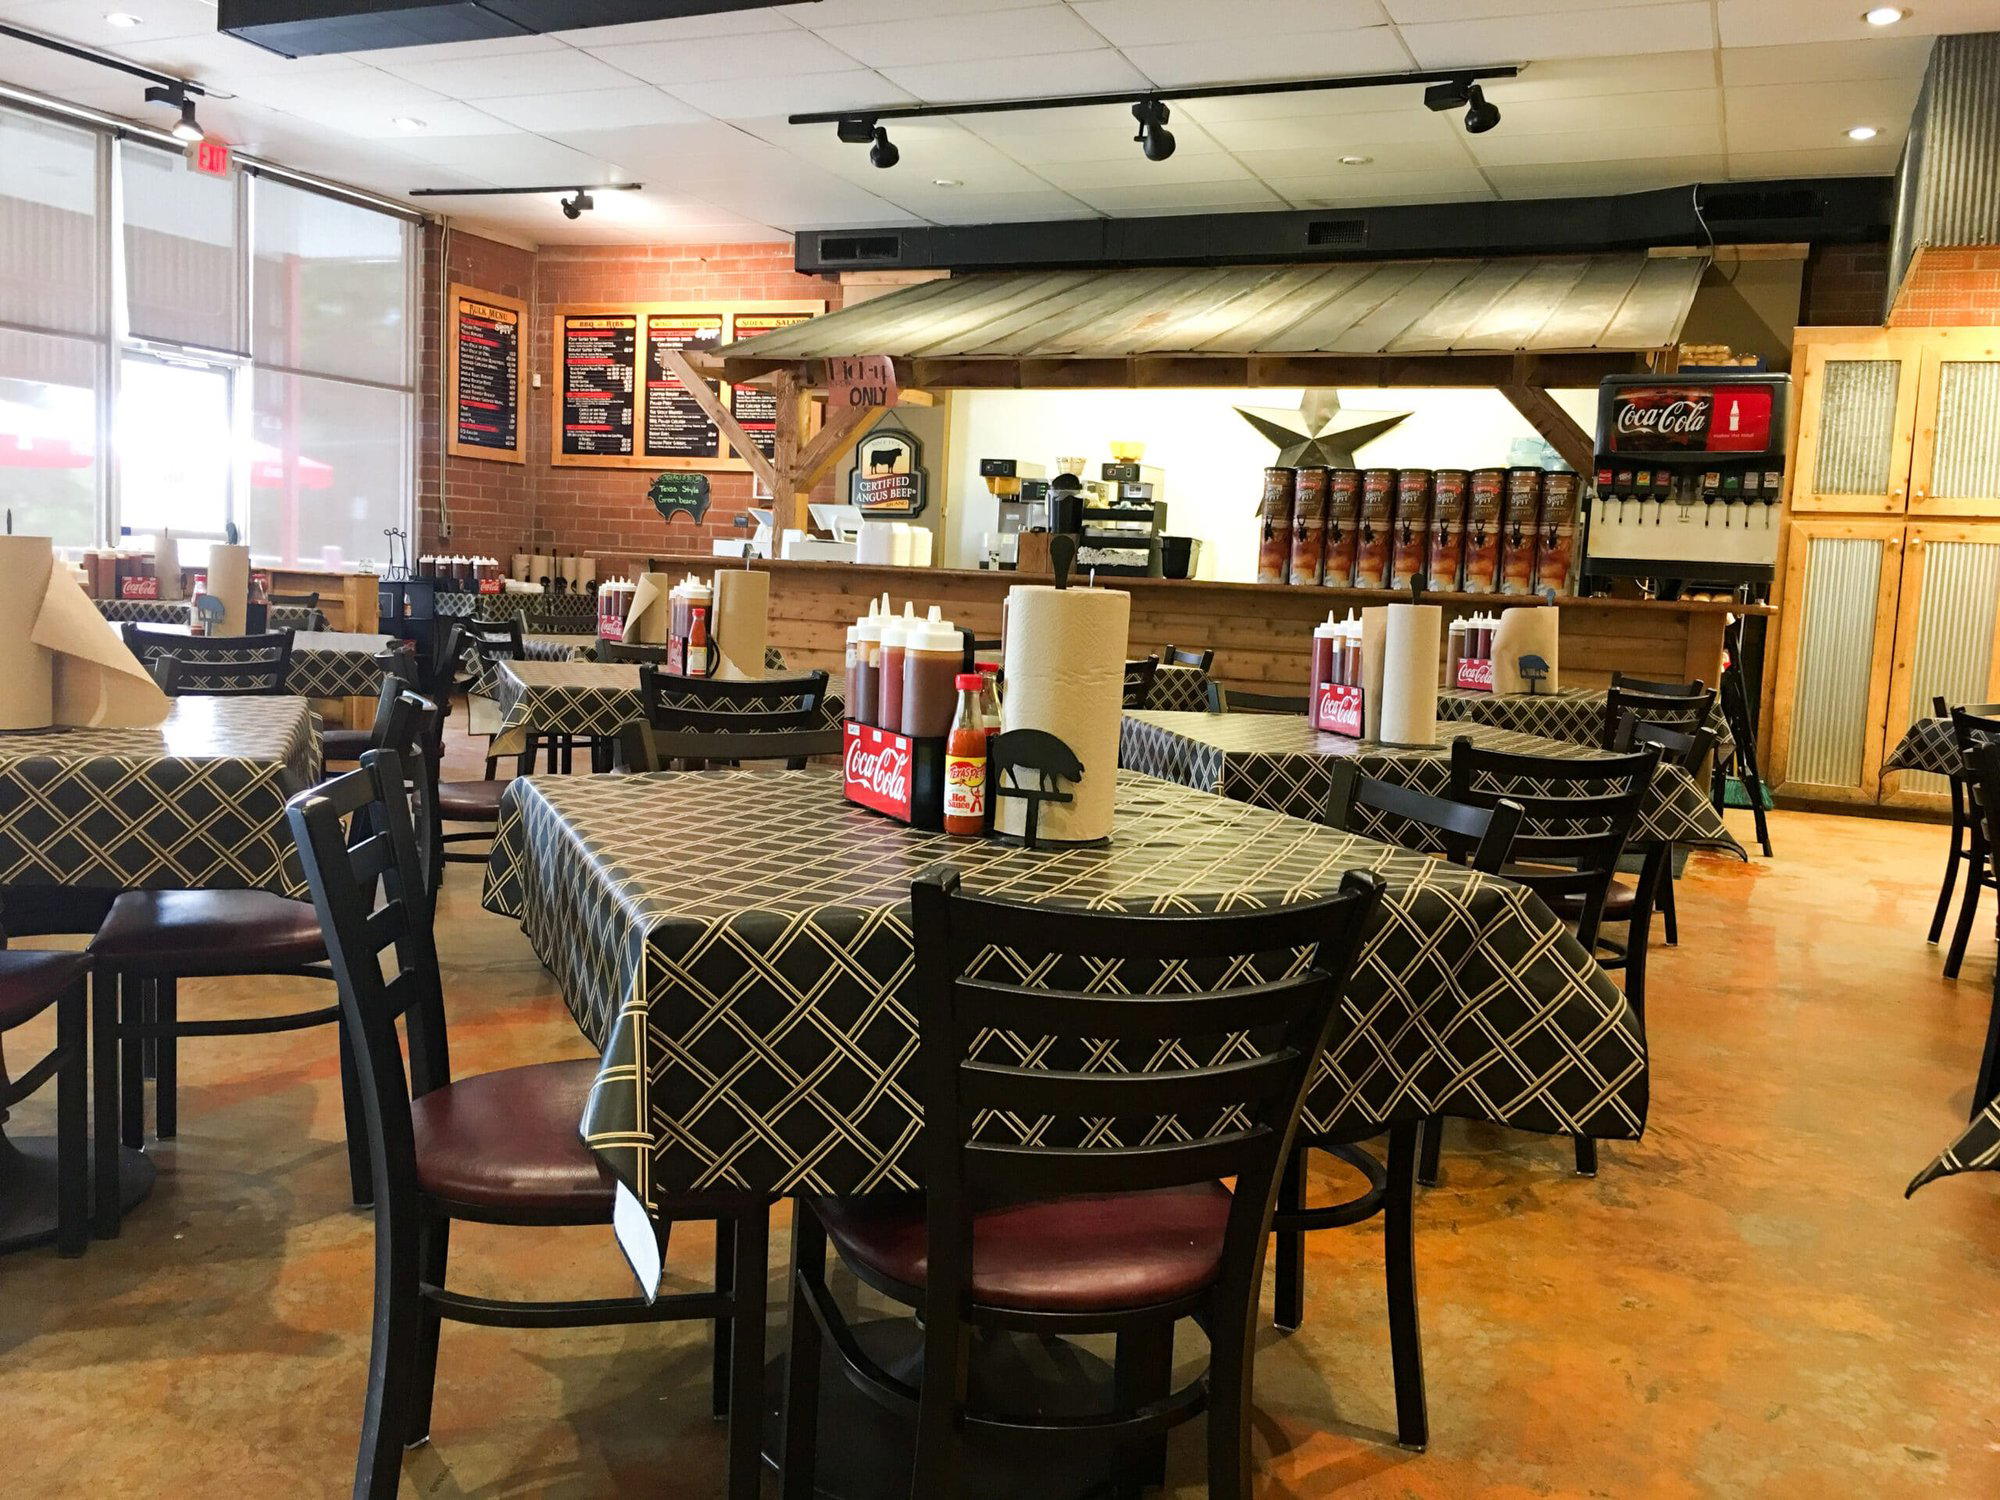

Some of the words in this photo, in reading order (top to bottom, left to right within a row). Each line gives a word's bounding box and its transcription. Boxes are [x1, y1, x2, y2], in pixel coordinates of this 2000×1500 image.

[198, 143, 228, 176] EXIT
[488, 308, 508, 320] MENU
[849, 386, 887, 406] ONLY
[1617, 401, 1709, 434] Coca-Cola
[860, 476, 909, 492] CERTIFIED
[856, 490, 888, 503] ANGUS
[1320, 692, 1360, 725] Coca-Cola
[846, 738, 909, 801] Coca-Cola
[948, 799, 970, 809] Sauce
[952, 793, 966, 802] Hot
